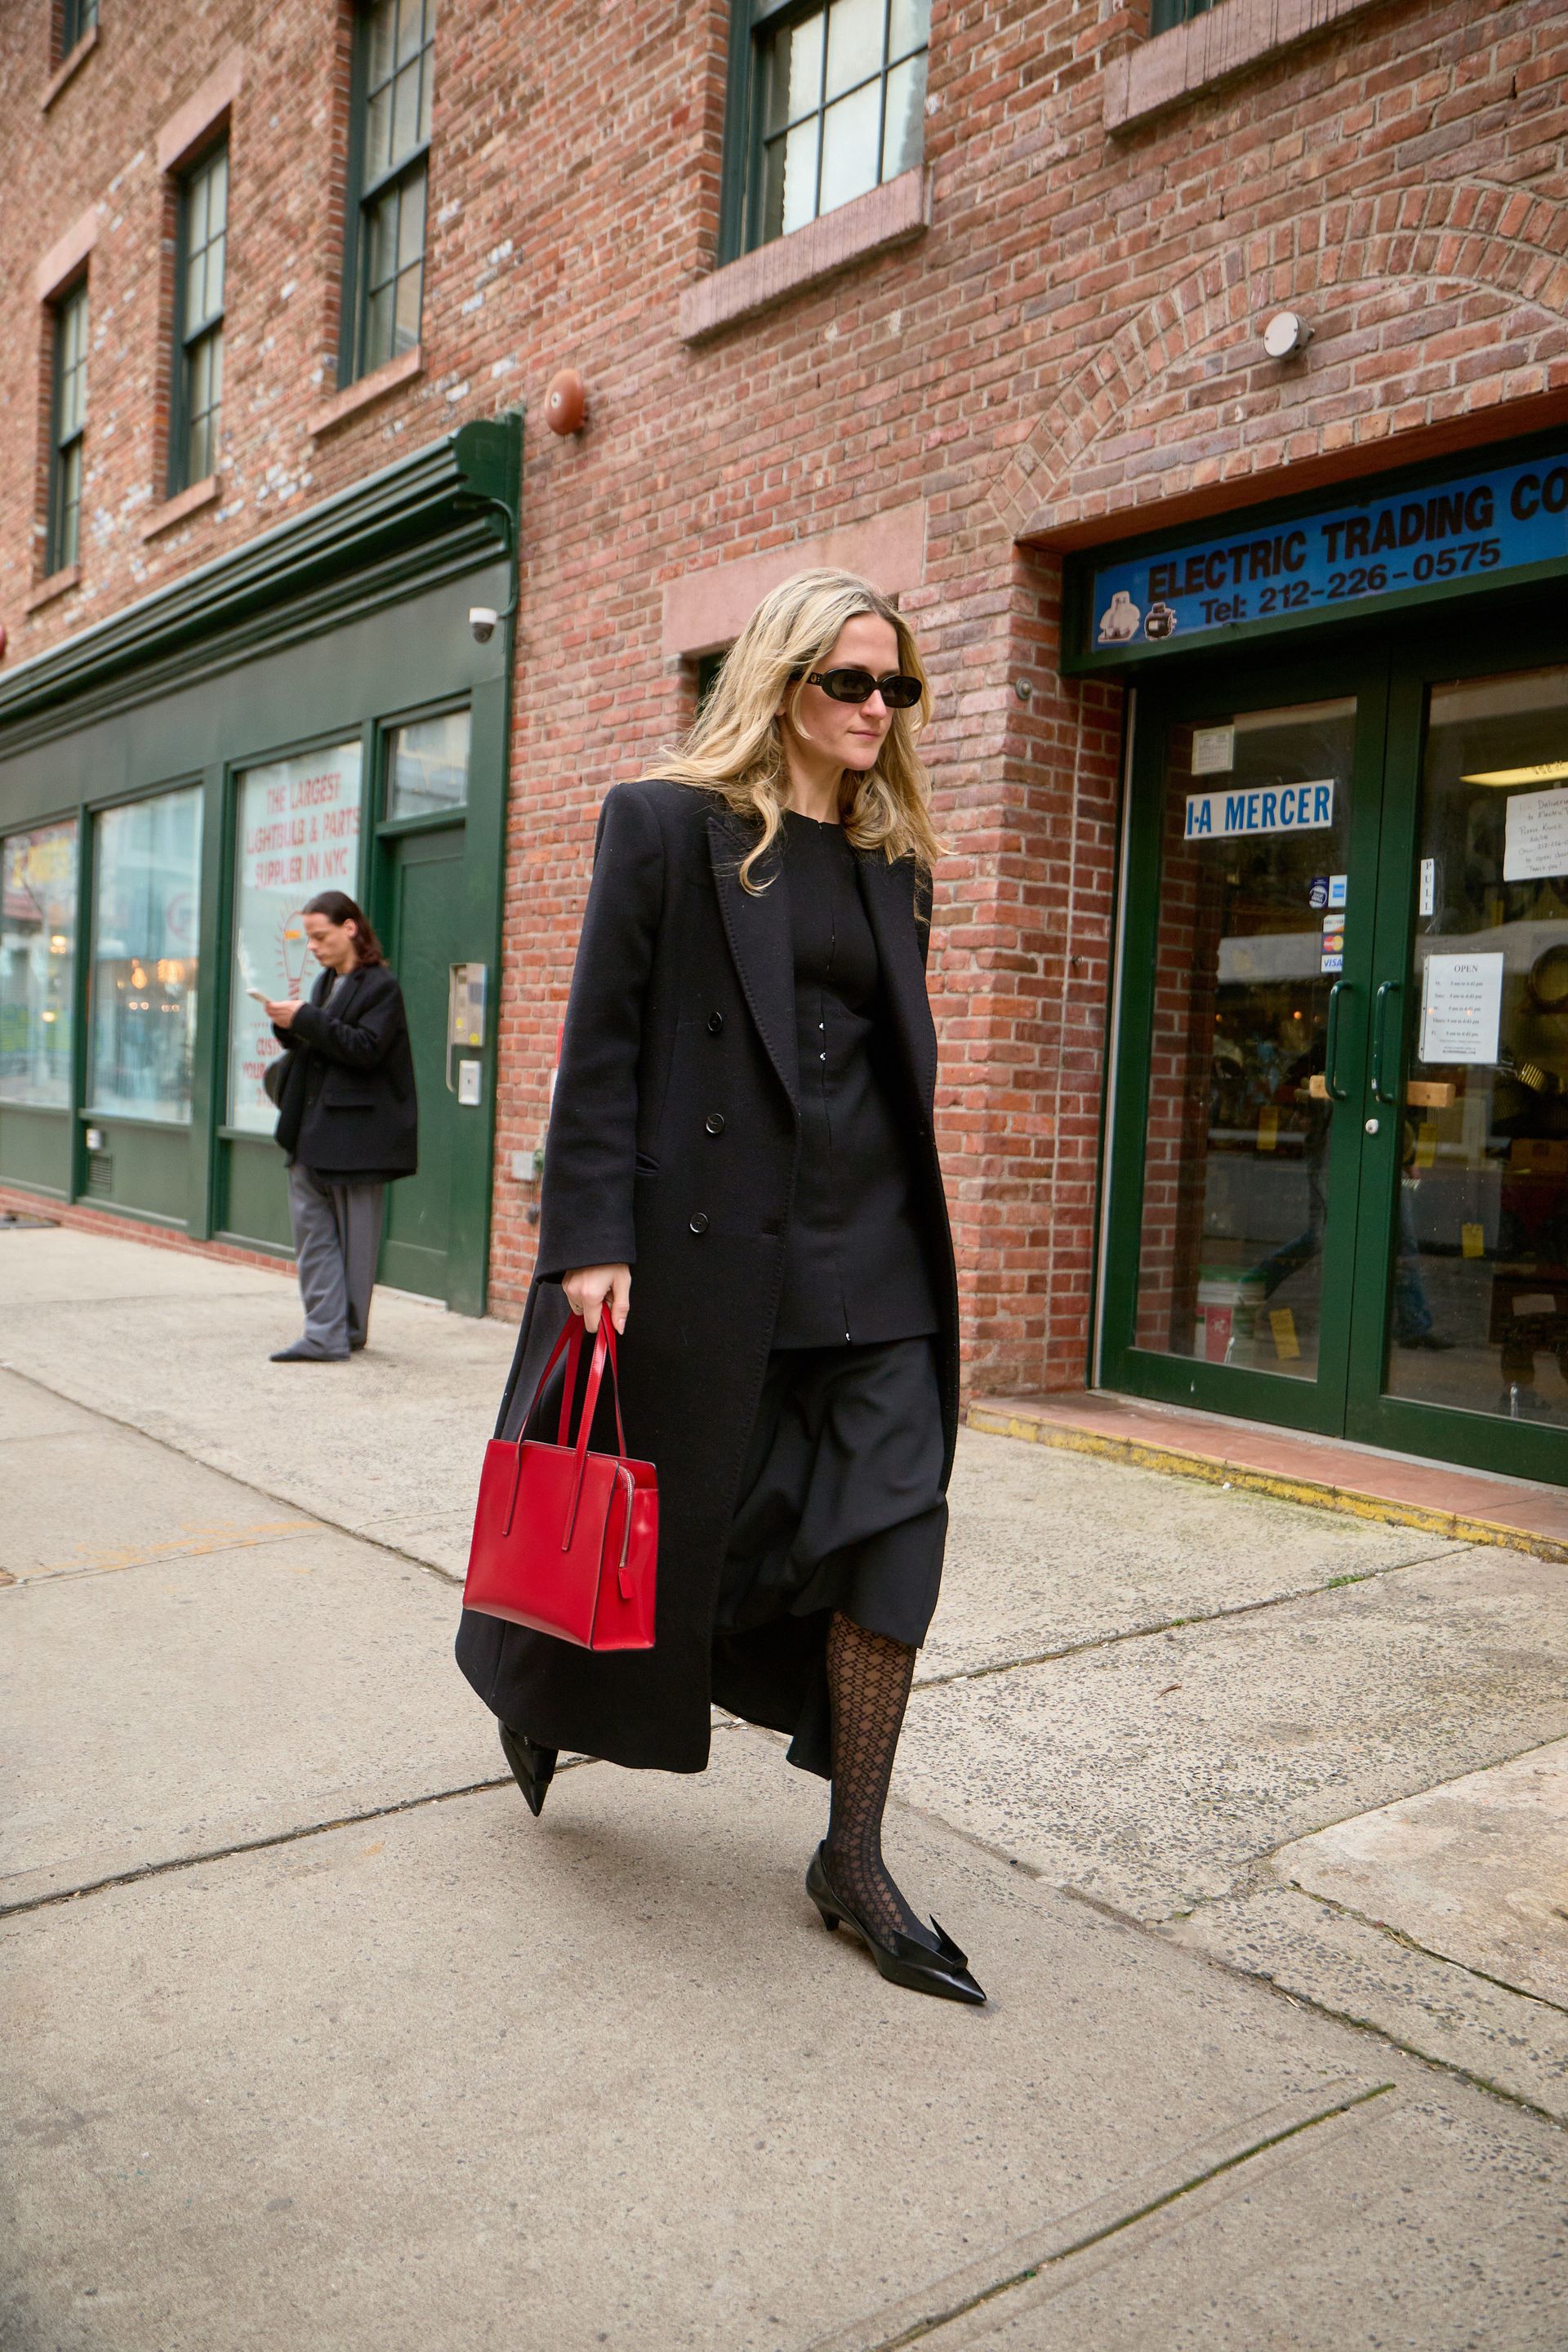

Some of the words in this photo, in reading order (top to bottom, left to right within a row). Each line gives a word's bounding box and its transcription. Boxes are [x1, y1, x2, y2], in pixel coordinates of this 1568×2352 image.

[1147, 531, 1306, 603] ELECTRIC
[1321, 486, 1494, 564] TRADING
[1510, 466, 1568, 520] CO
[1199, 595, 1247, 624] Tel:
[267, 786, 287, 814] THE
[290, 772, 341, 810] LARGEST
[1225, 786, 1330, 831] MERCER
[247, 819, 305, 854] LIGHTBULB
[323, 806, 360, 840] PARTS
[255, 856, 302, 889] SUPPLIER
[307, 852, 319, 880] IN
[323, 847, 349, 876] NYC
[1324, 959, 1343, 968] VISA
[1454, 964, 1478, 973] OPEN
